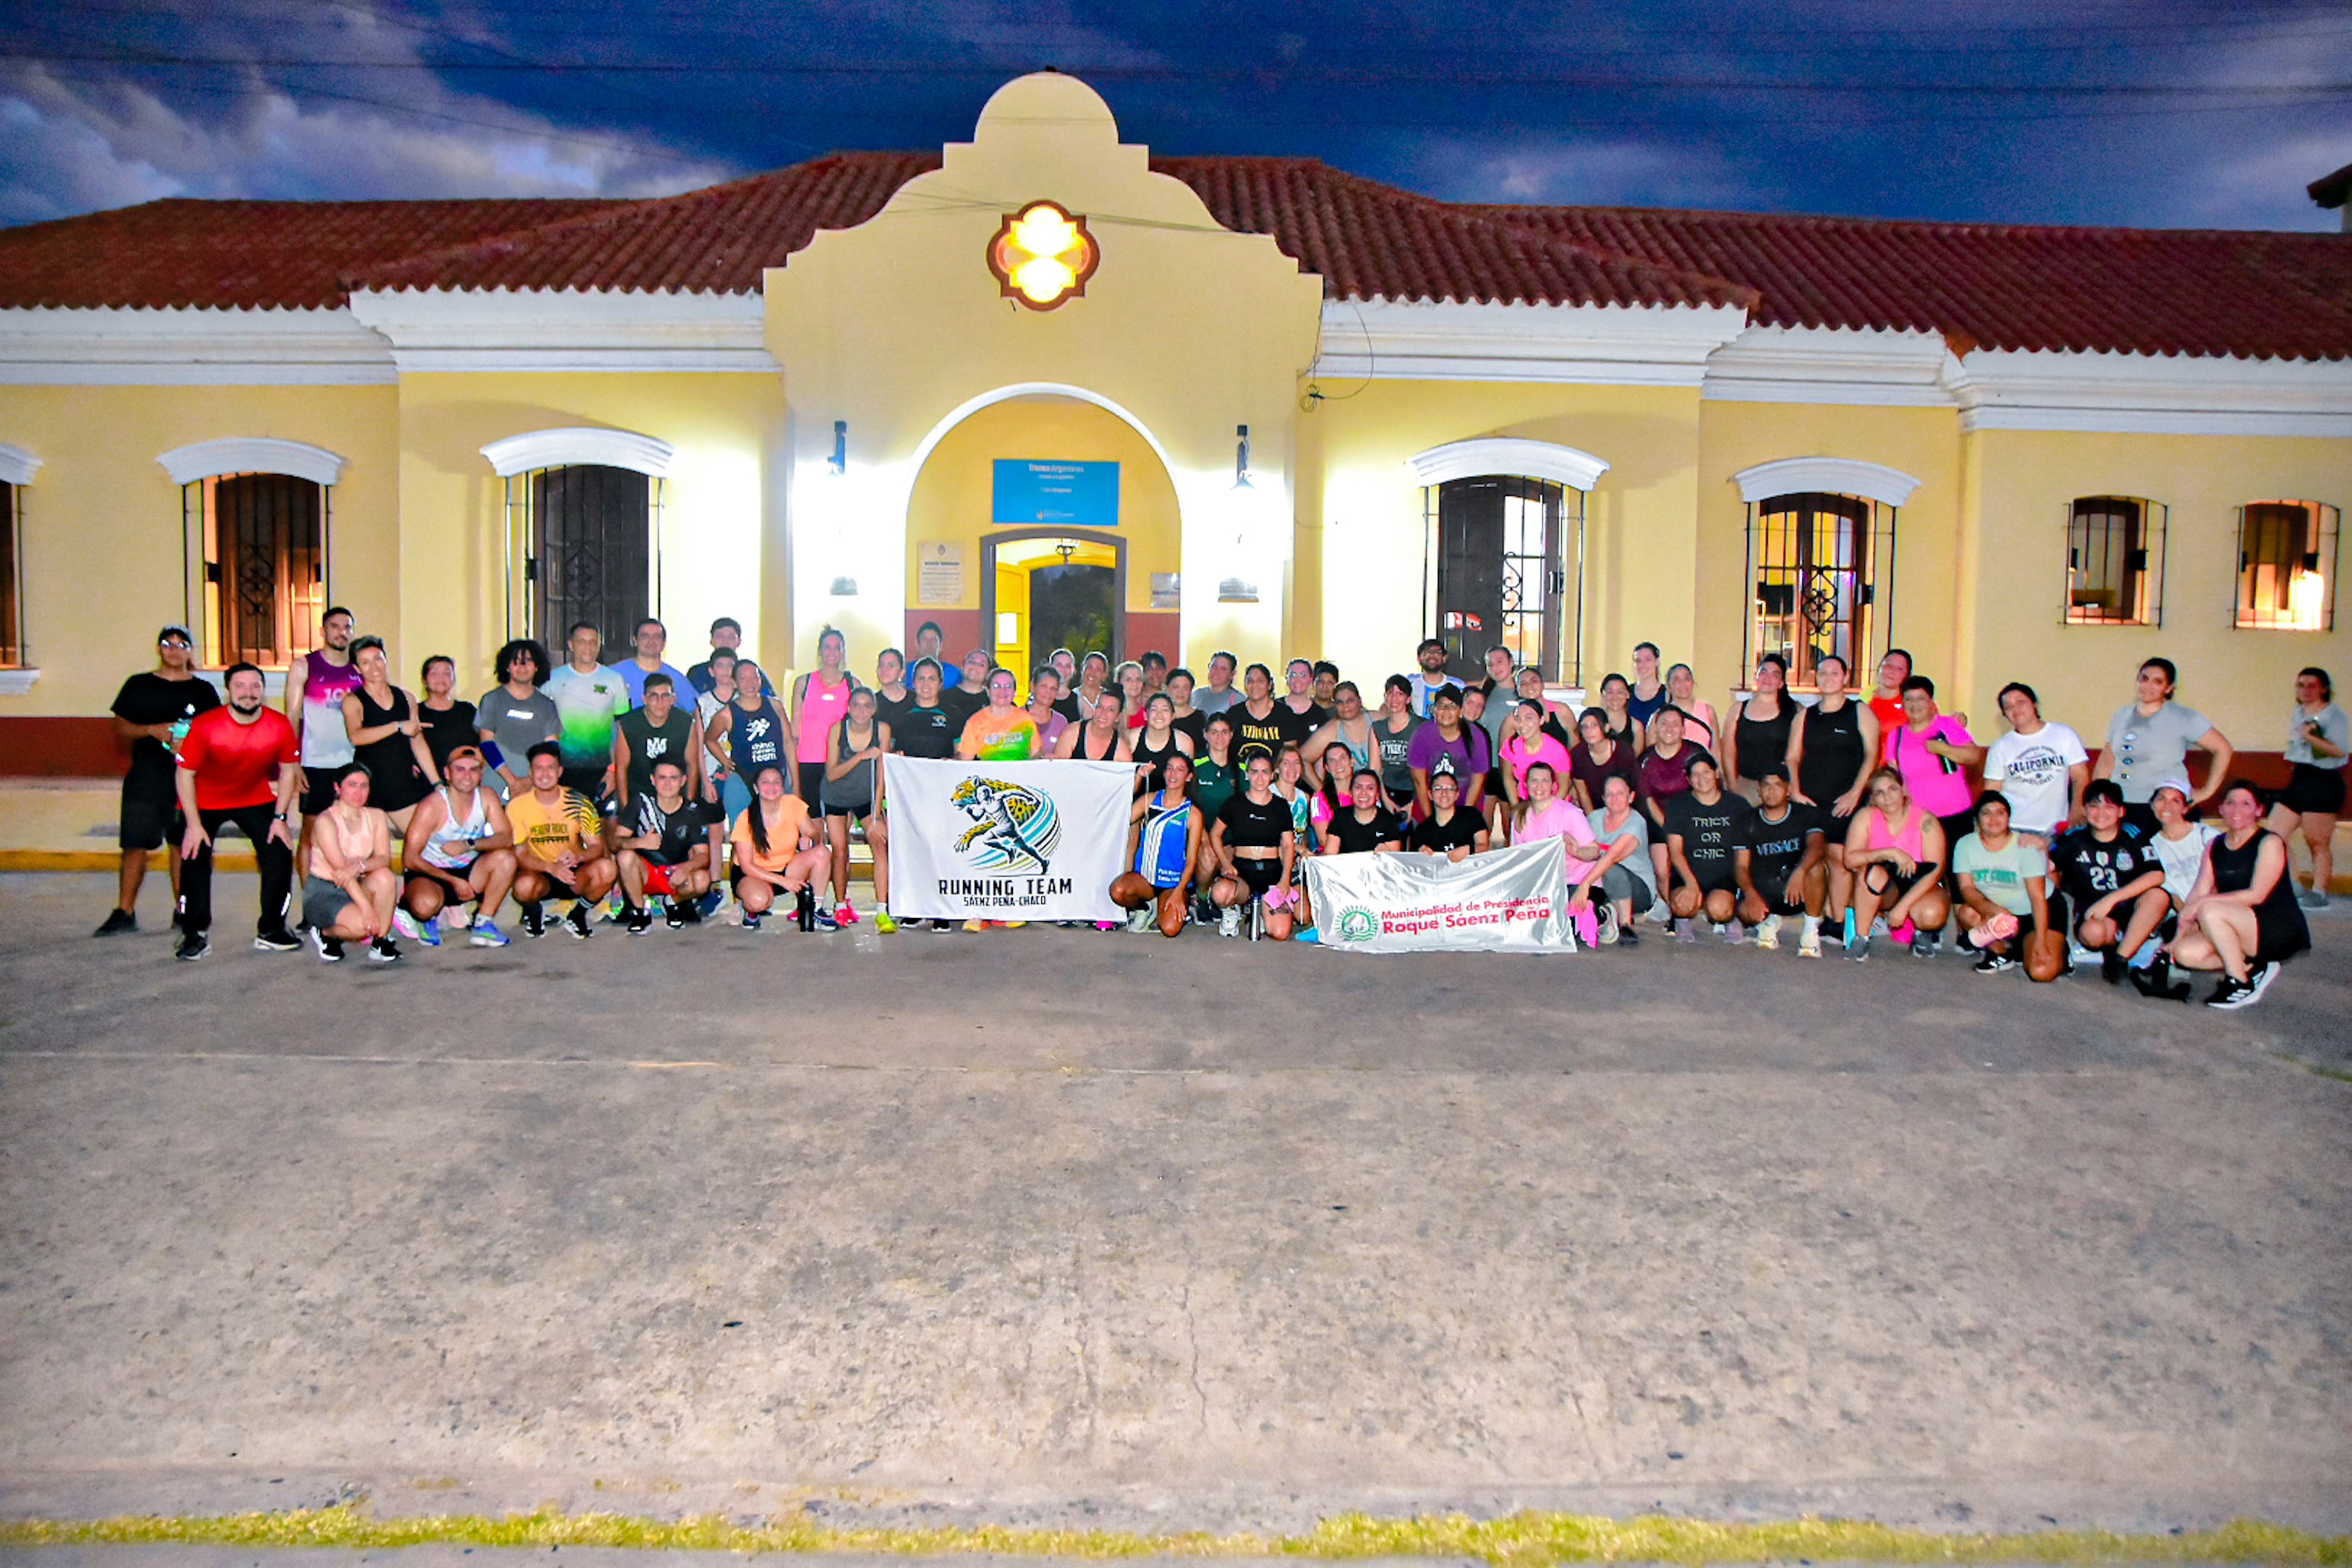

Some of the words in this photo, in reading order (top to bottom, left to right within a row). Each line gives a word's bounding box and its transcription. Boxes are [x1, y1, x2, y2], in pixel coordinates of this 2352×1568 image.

[2007, 754, 2065, 776] CALIFORNIA
[1691, 816, 1730, 828] TRICK
[1700, 831, 1722, 843] OR
[1756, 837, 1800, 856] VERSACE
[1693, 848, 1725, 859] CHIC
[938, 879, 1014, 896] RUNNING
[1026, 878, 1073, 895] TEAM
[2089, 865, 2118, 891] 23
[1381, 903, 1462, 920] Municipalidad
[1466, 902, 1481, 911] de
[1484, 895, 1550, 910] Presidencia
[1383, 918, 1440, 935] Roque
[1446, 912, 1499, 928] Sáenz
[1504, 906, 1551, 923] Peña
